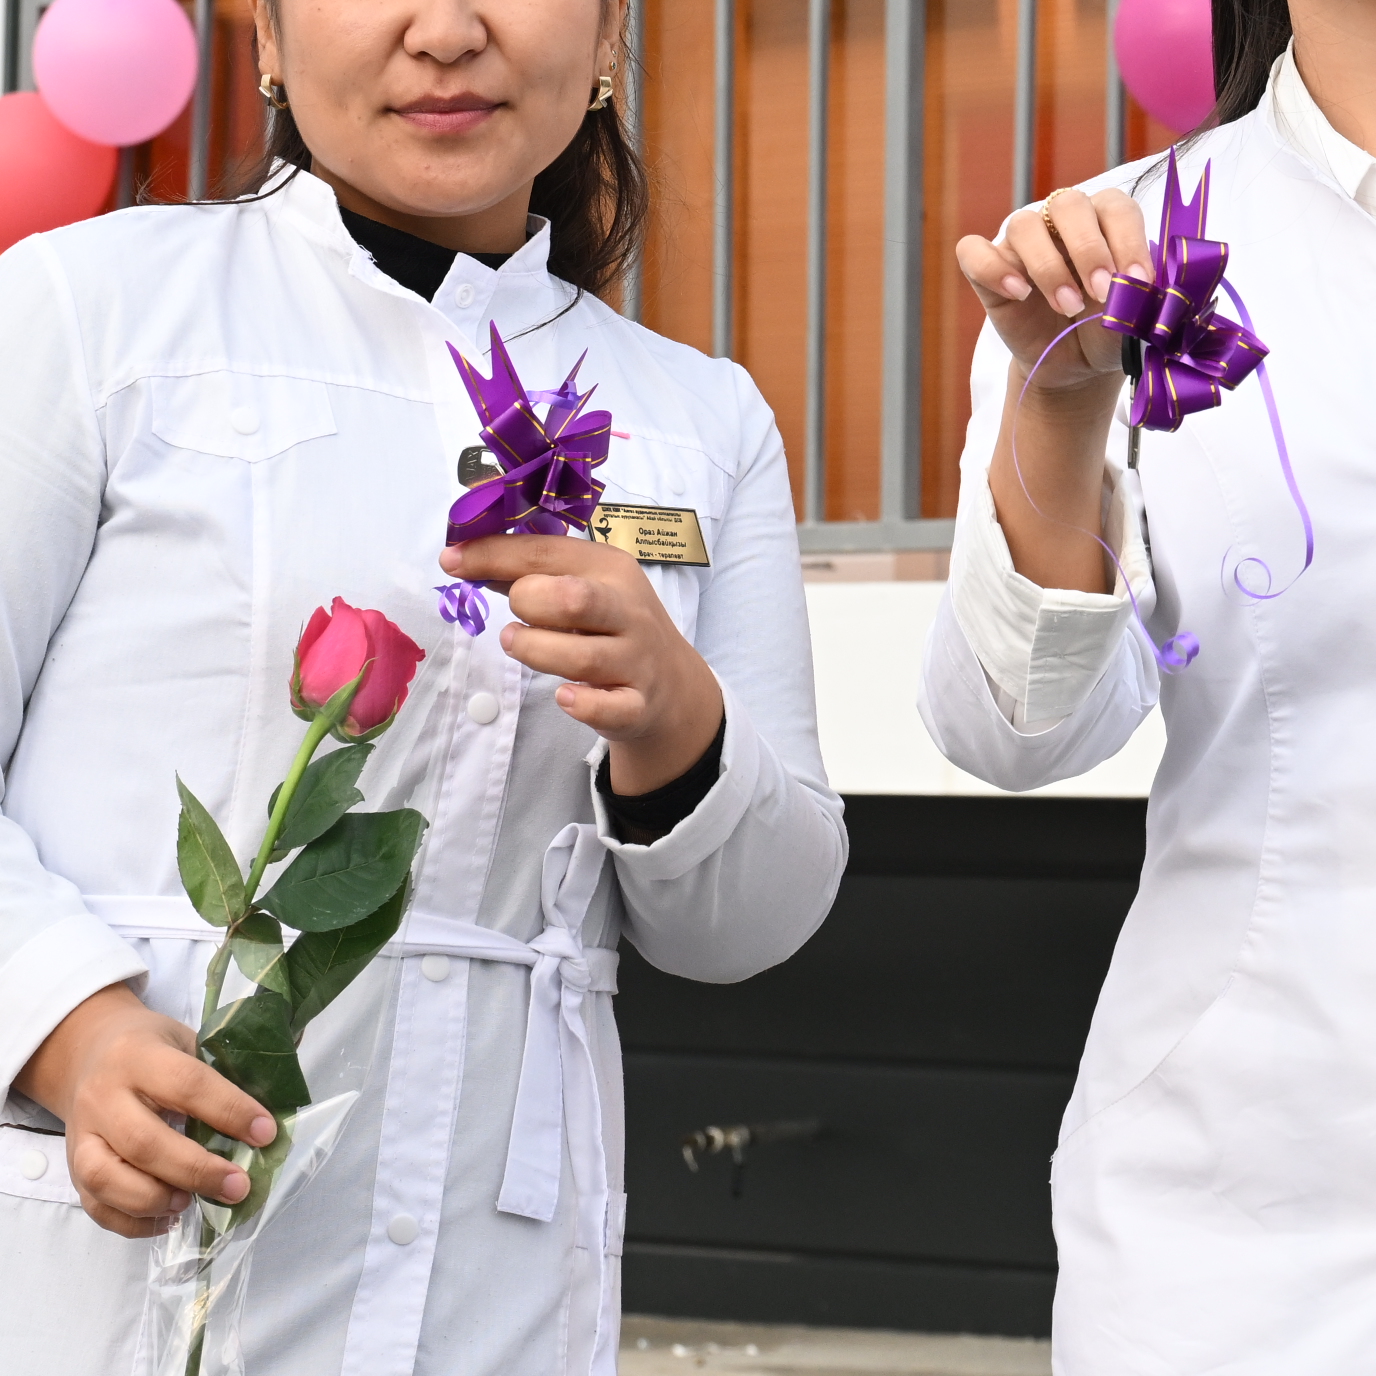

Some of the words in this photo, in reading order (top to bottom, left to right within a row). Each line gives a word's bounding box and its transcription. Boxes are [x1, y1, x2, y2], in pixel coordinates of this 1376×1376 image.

[638, 527, 655, 536] Ораз
[656, 528, 678, 537] Айжан
[638, 549, 654, 558] Врач
[658, 551, 684, 559] терапевт
